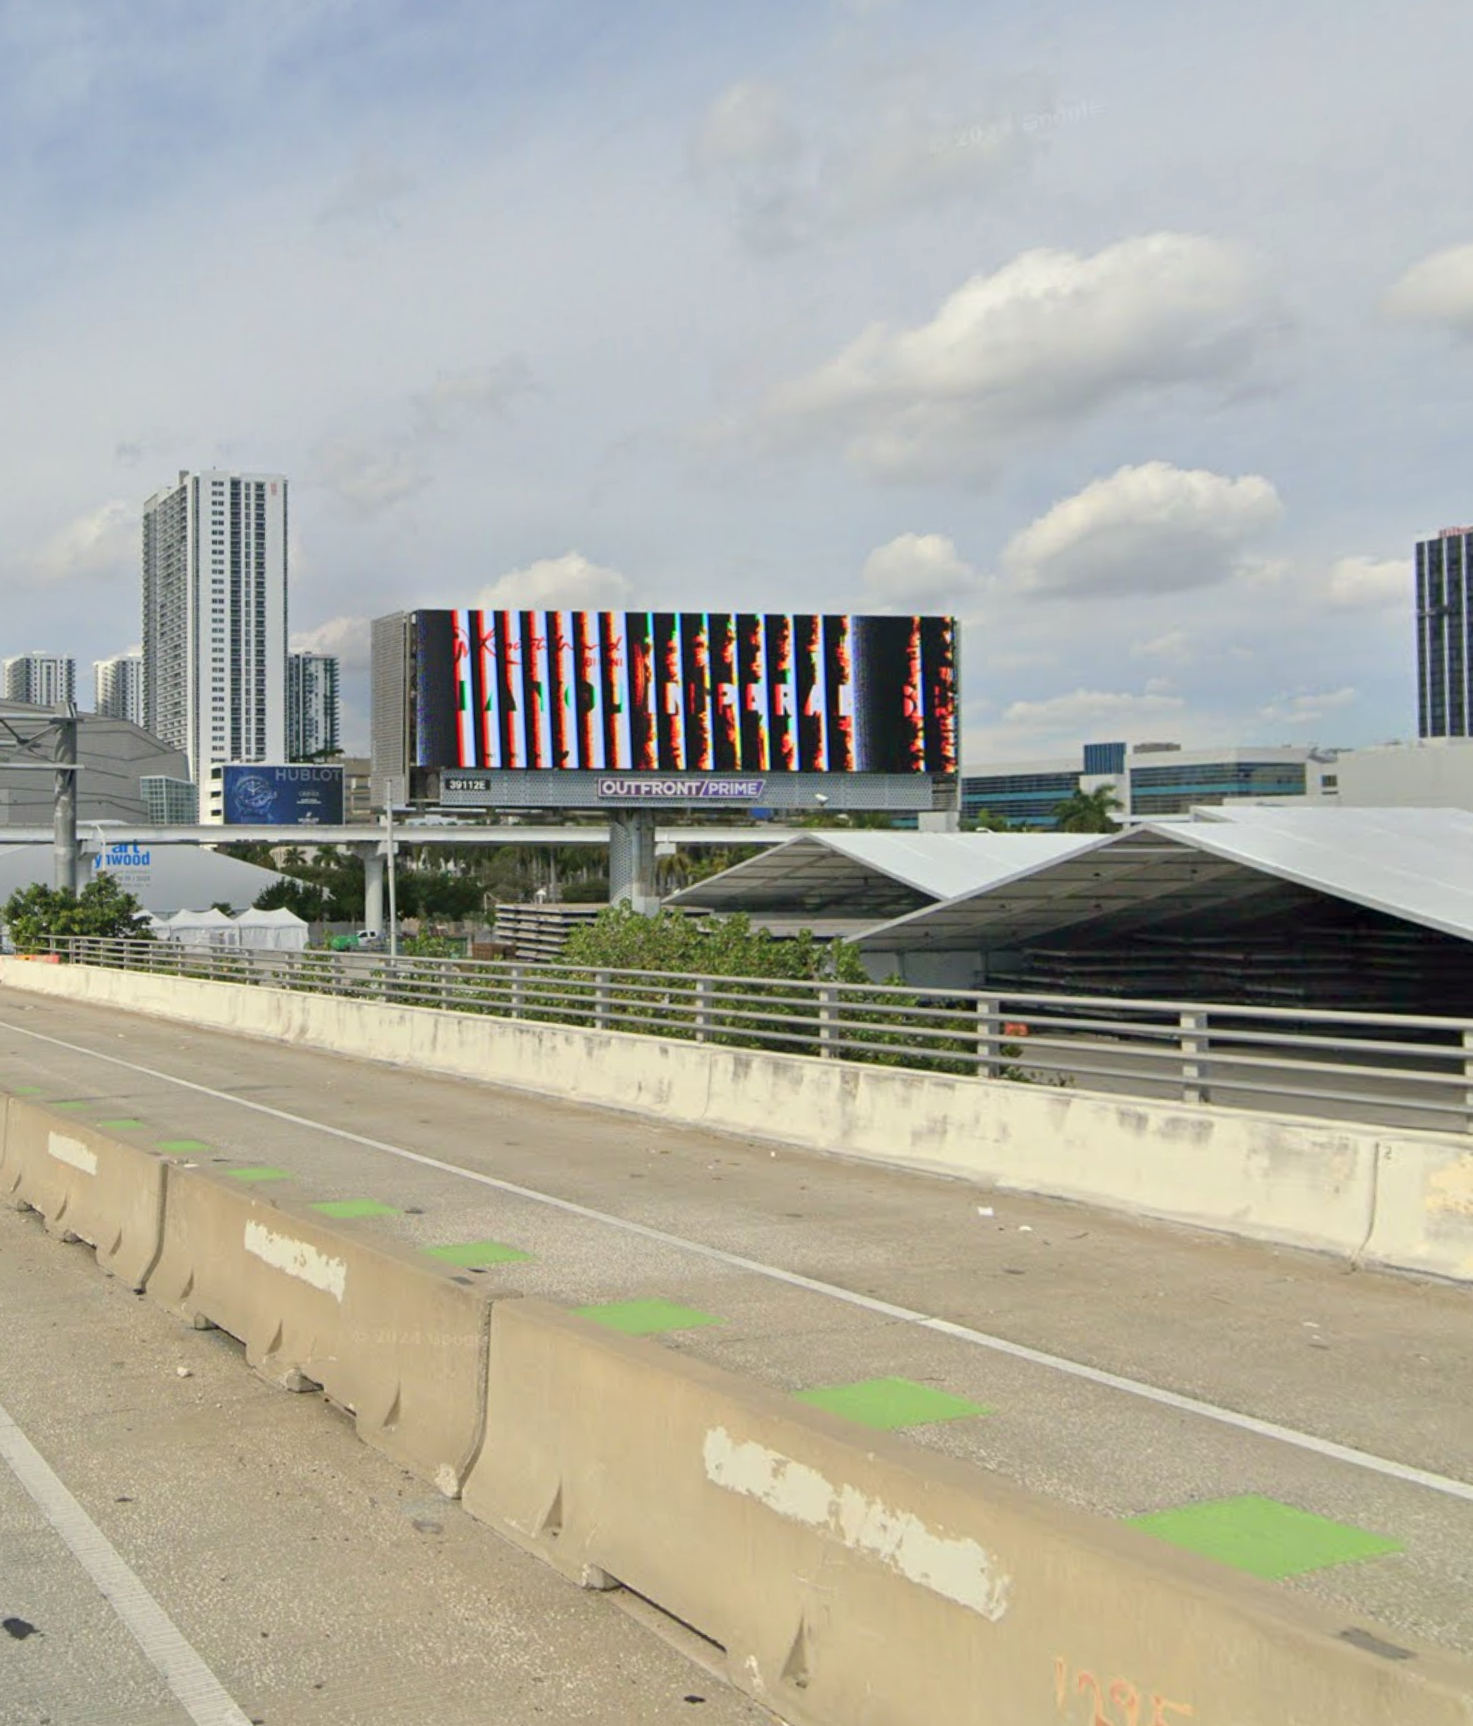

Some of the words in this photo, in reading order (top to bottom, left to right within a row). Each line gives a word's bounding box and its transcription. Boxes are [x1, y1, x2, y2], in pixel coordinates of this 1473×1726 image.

[276, 769, 342, 782] HUBLOT
[449, 780, 486, 790] 39112E
[93, 850, 151, 869] ynwood
